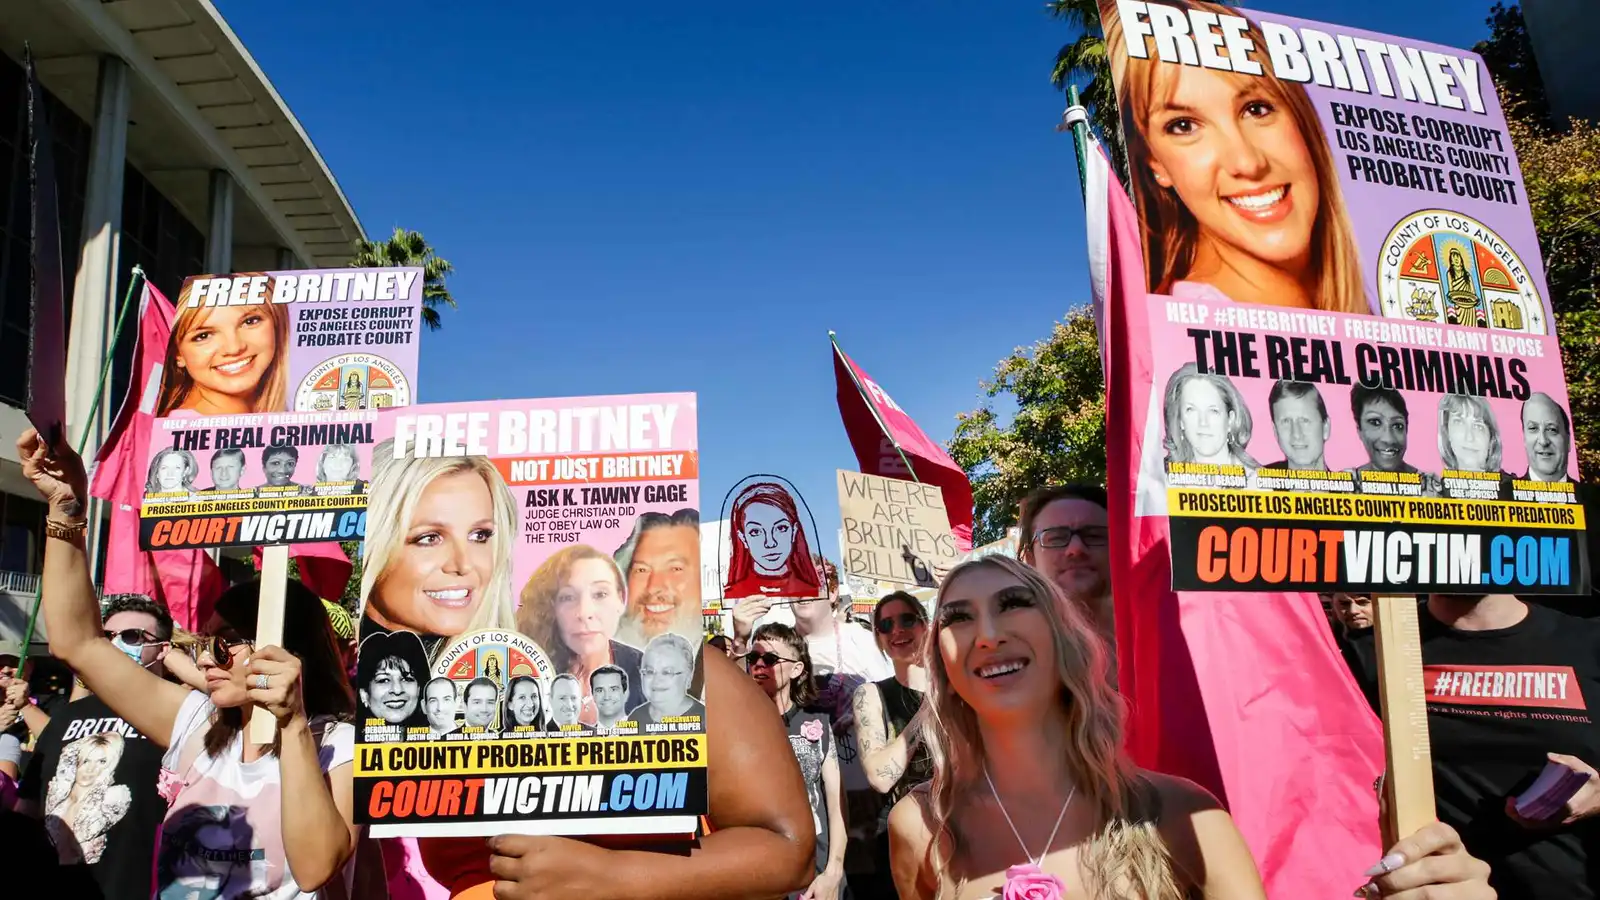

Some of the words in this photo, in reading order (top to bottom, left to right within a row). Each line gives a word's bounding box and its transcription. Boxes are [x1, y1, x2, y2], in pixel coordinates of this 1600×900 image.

[1116, 0, 1266, 76] FREE
[1260, 19, 1487, 116] BRITNEY
[1330, 101, 1410, 138] EXPOSE
[1413, 115, 1505, 152] CORRUPT
[1336, 128, 1370, 153] LOS
[1373, 133, 1446, 164] ANGELES
[1447, 148, 1511, 175] COUNTY
[1346, 154, 1448, 194] PROBATE
[1450, 169, 1519, 205] COURT
[1386, 223, 1421, 267] COUNTY
[1423, 215, 1442, 230] OF
[1445, 215, 1469, 233] LOS
[1472, 227, 1527, 285] ANGELES
[187, 274, 270, 308] FREE
[272, 271, 418, 304] BRITNEY
[297, 321, 317, 332] LOS
[319, 320, 367, 332] ANGELES
[368, 319, 413, 330] COUNTY
[299, 308, 350, 321] EXPOSE
[351, 306, 414, 319] CORRUPT
[297, 332, 362, 347] PROBATE
[364, 331, 413, 345] COURT
[1165, 302, 1209, 325] HELP
[1213, 306, 1336, 337] #FREEBRITNEY
[1343, 317, 1489, 352] FREEBRITNEY.ARMY
[1491, 337, 1544, 358] EXPOSE
[305, 361, 335, 387] COUNTY
[337, 356, 351, 365] OF
[353, 356, 369, 364] LOS
[372, 359, 402, 385] ANGELES
[1187, 328, 1260, 378] THE
[1267, 336, 1351, 387] REAL
[1354, 344, 1531, 401] CRIMINALS
[163, 419, 187, 429] HELP
[171, 429, 211, 451] THE
[215, 427, 265, 449] REAL
[270, 422, 374, 448] CRIMINAL
[392, 411, 490, 460] FREE
[497, 403, 679, 456] BRITNEY
[511, 460, 550, 482] NOT
[551, 457, 600, 481] JUST
[602, 454, 684, 478] BRITNEY
[1168, 461, 1184, 473] LOS
[1185, 462, 1219, 475] ANGELES
[1168, 472, 1208, 485] CANDACE
[1361, 470, 1398, 482] PRESIDING
[1399, 472, 1420, 483] JUDGE
[525, 488, 559, 507] ASK
[563, 488, 578, 506] K.
[580, 485, 641, 505] TAWNY
[644, 483, 688, 503] GAGE
[841, 472, 945, 510] WHERE
[1256, 477, 1310, 489] CHRISTOPHER
[147, 504, 196, 515] PROSECUTE
[198, 503, 213, 513] LOS
[214, 501, 250, 512] ANGELES
[252, 500, 286, 510] COUNTY
[287, 497, 325, 508] PROBATE
[327, 496, 355, 507] COURT
[525, 508, 559, 519] JUDGE
[562, 507, 616, 518] CHRISTIAN
[618, 506, 635, 516] DID
[872, 503, 922, 526] ARE
[1179, 492, 1262, 513] PROSECUTE
[1265, 496, 1292, 514] LOS
[1294, 496, 1352, 516] ANGELES
[1355, 499, 1405, 519] COUNTY
[1409, 501, 1465, 520] PROBATE
[1467, 504, 1505, 522] COURT
[1509, 505, 1575, 525] PREDATORS
[150, 511, 367, 547] COURTVICTIM.CO
[525, 520, 546, 531] NOT
[548, 520, 577, 530] OBEY
[579, 519, 602, 530] LAW
[604, 518, 620, 529] OR
[525, 533, 544, 543] THE
[547, 532, 580, 543] TRUST
[1196, 524, 1570, 587] COURTVICTIM.COM
[437, 636, 470, 676] COUNTY
[472, 633, 489, 645] OF
[490, 633, 508, 644] LOS
[510, 636, 547, 673] ANGELES
[1433, 671, 1568, 700] #FREEBRITNEY
[365, 718, 385, 726] JUDGE
[615, 720, 638, 728] LAWYER
[1450, 706, 1491, 717] human
[1494, 709, 1528, 720] rights
[62, 717, 147, 741] BRITN
[364, 733, 400, 742] CHRISTIAN
[646, 723, 669, 732] KAREN
[669, 723, 677, 732] M.
[678, 722, 701, 731] ROPER
[360, 747, 384, 771] LA
[388, 745, 472, 770] COUNTY
[477, 742, 571, 769] PROBATE
[578, 738, 700, 766] PREDATORS
[368, 771, 689, 818] COURTVICTIM.COM
